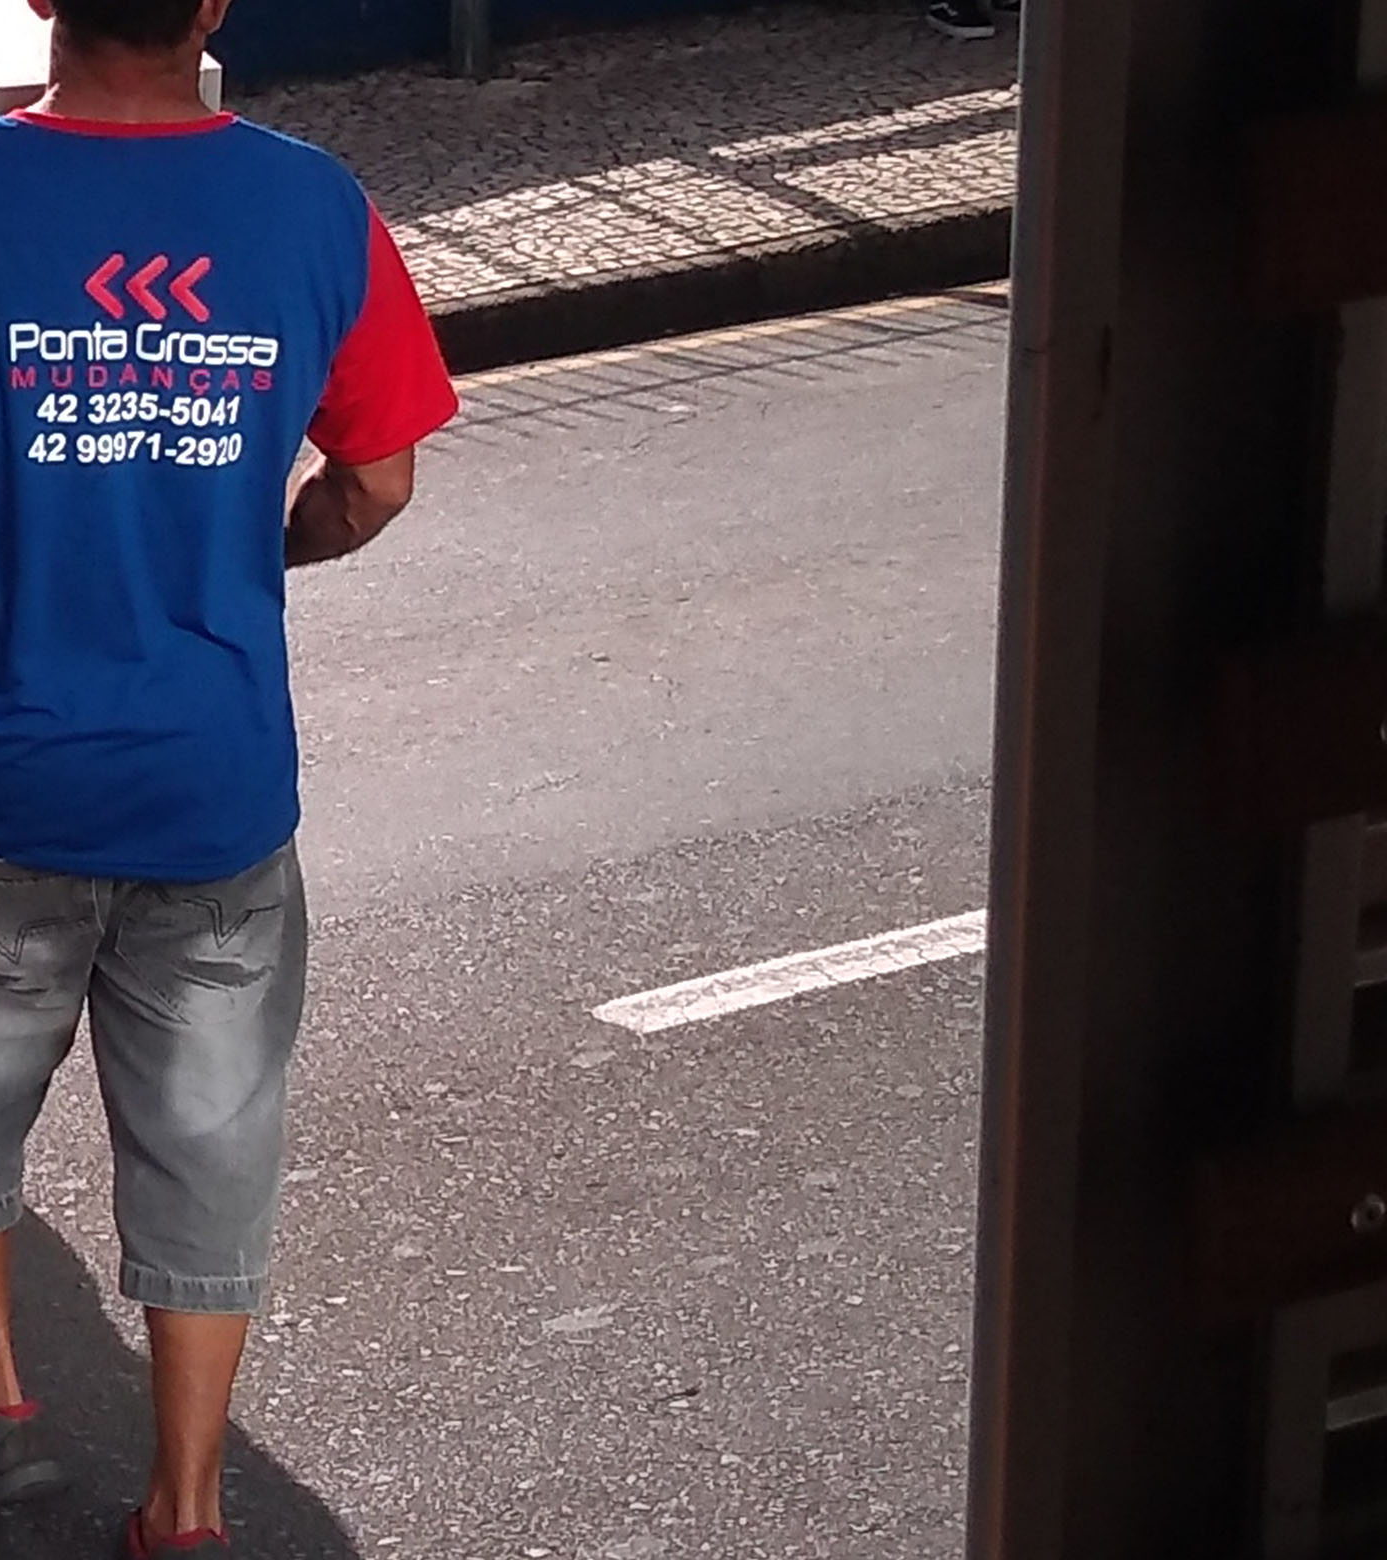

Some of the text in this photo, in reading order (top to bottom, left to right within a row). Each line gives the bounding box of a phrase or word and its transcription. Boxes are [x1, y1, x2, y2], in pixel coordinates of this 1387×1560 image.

[9, 321, 278, 367] Ponta Grossa
[10, 363, 273, 395] MUDANÇAS
[36, 391, 241, 426] 42 3235-5041
[27, 430, 243, 466] 42 99971-2920
